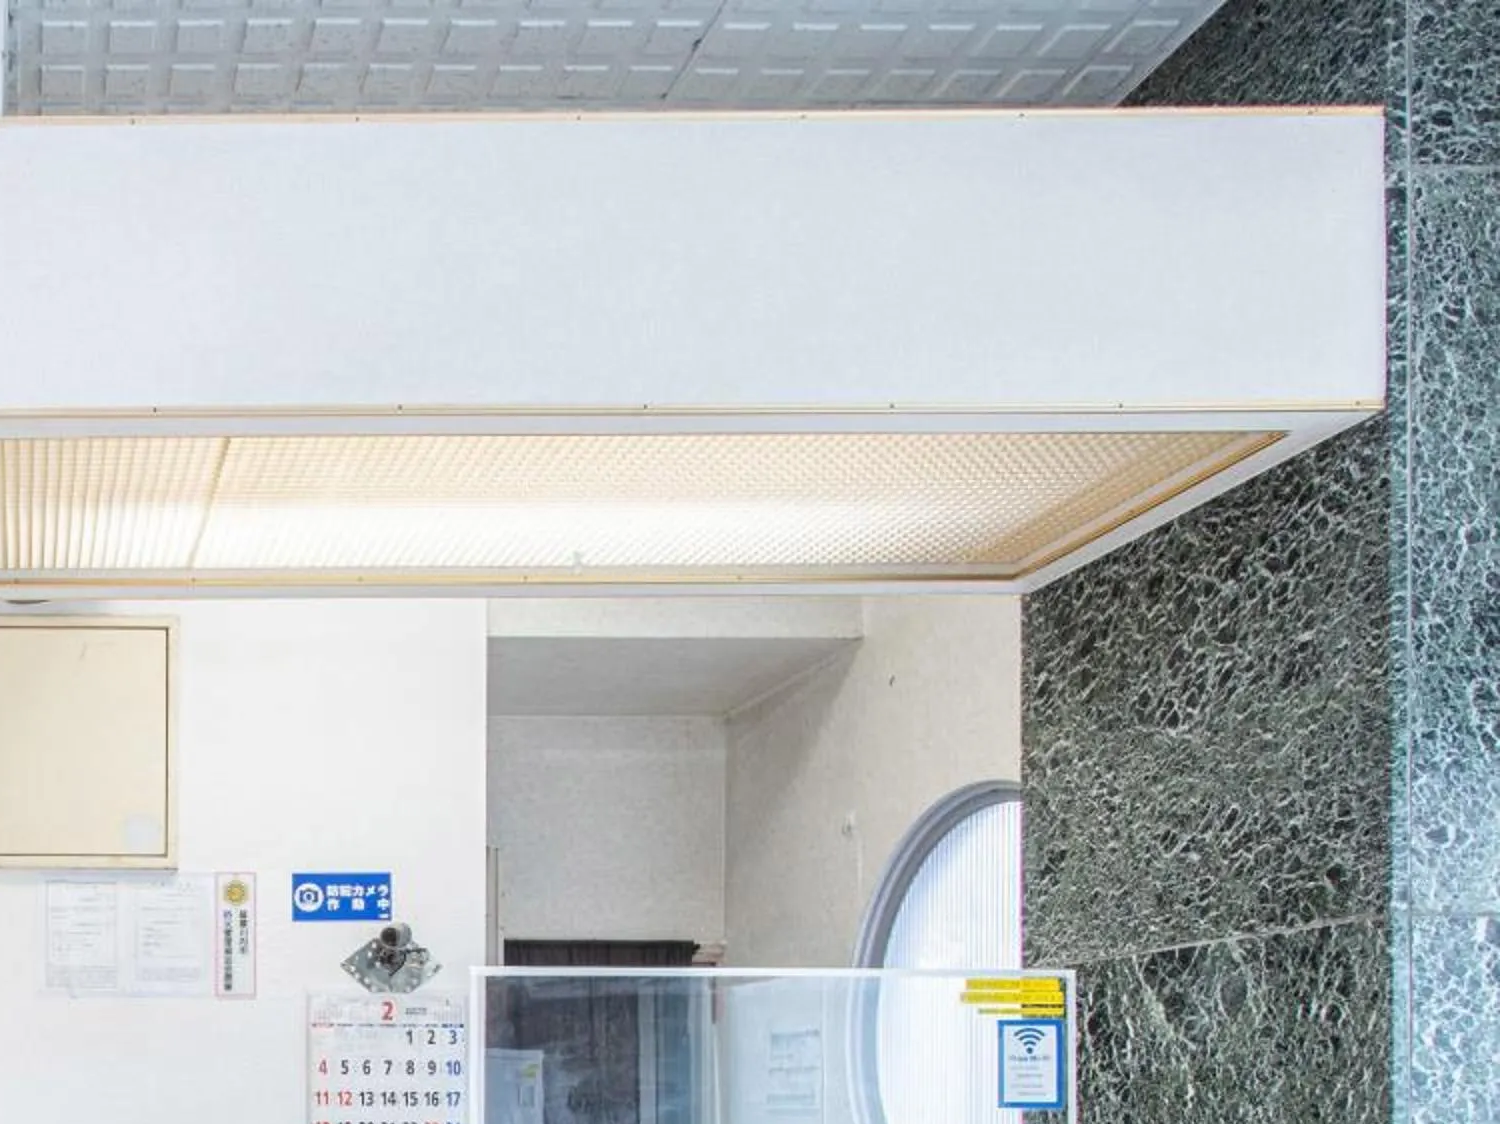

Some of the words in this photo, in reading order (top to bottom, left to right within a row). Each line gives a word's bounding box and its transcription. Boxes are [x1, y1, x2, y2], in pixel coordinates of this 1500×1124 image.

[382, 1002, 394, 1021] 2
[405, 1030, 413, 1045] 1
[427, 1030, 436, 1045] 2
[448, 1030, 458, 1045] 3
[319, 1060, 328, 1075] 4
[341, 1060, 349, 1075] 5
[362, 1060, 371, 1075] 6
[383, 1060, 393, 1075] 7
[405, 1060, 415, 1076] 8
[427, 1060, 437, 1076] 9
[445, 1060, 462, 1076] 10
[315, 1092, 330, 1107] 11
[337, 1091, 353, 1107] 12
[359, 1092, 374, 1107] 13
[381, 1092, 397, 1106] 14
[402, 1092, 419, 1107] 15
[424, 1092, 440, 1107] 16
[445, 1092, 461, 1107] 17
